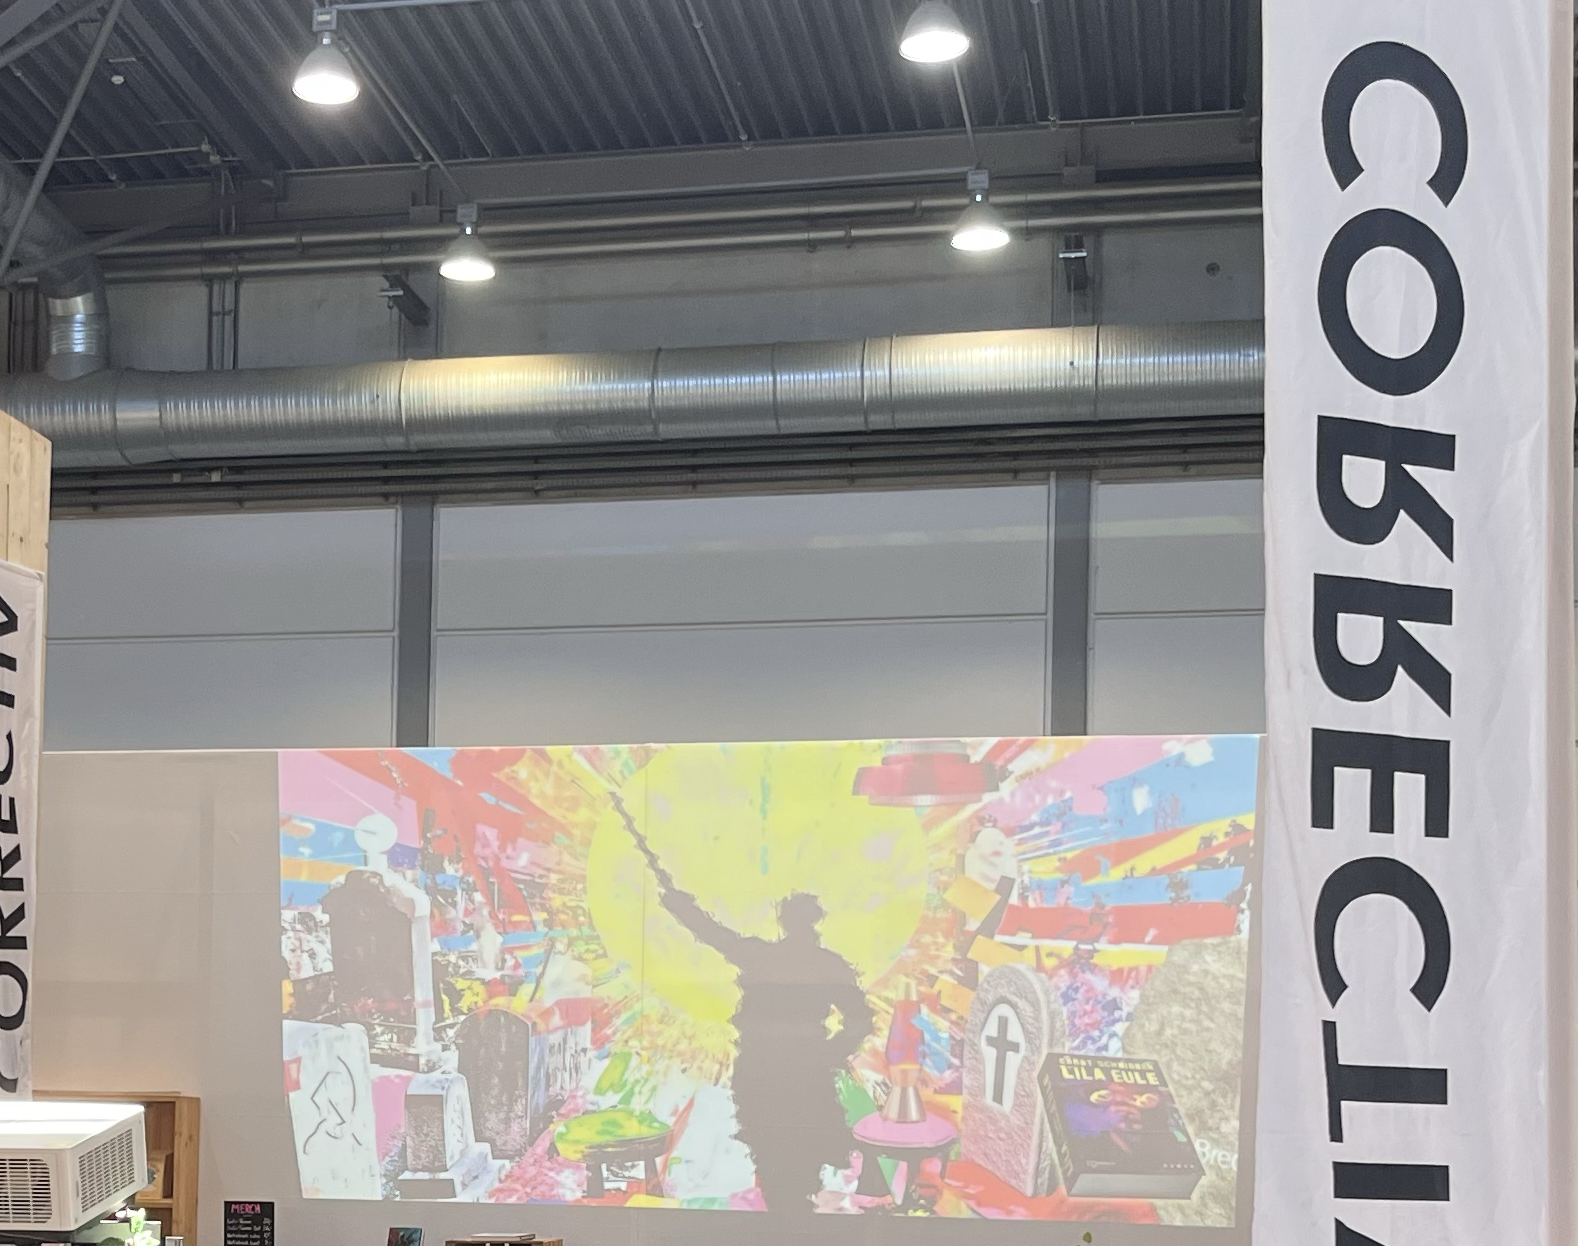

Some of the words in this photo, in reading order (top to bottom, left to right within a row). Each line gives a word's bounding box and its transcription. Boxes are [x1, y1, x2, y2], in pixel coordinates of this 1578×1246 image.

[1059, 1065, 1105, 1082] LILA
[1111, 1069, 1160, 1085] EULE
[230, 1203, 261, 1215] MERCH
